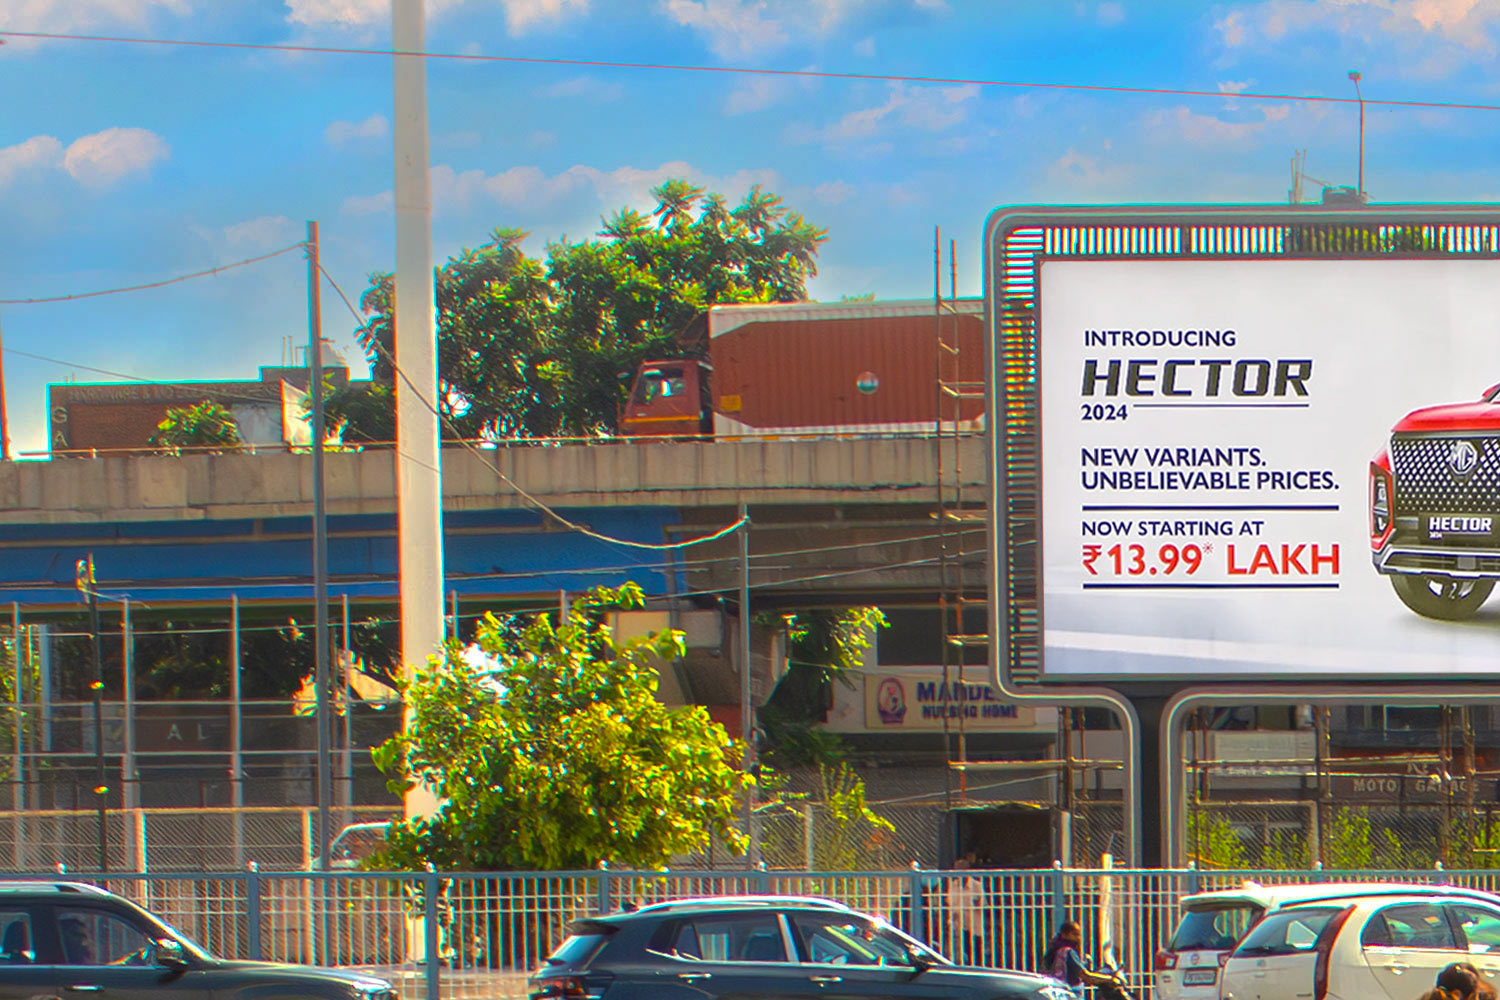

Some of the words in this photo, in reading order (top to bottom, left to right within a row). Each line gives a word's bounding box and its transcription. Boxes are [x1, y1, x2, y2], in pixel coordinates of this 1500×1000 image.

[1084, 330, 1236, 347] INTRODUCING
[1081, 359, 1312, 397] HECTOR
[1081, 404, 1128, 420] 2024
[1082, 449, 1138, 467] NEW
[1143, 448, 1266, 467] VARIANTS.
[1082, 472, 1250, 490] UNBELIEVABLE
[1257, 471, 1340, 490] PRICES.
[1082, 521, 1133, 536] NOW
[1138, 521, 1233, 536] STARTING
[1239, 521, 1264, 536] AT
[1429, 516, 1492, 532] HECTOR
[1227, 544, 1340, 575] LAKH
[981, 705, 1018, 719] HOME
[1353, 779, 1397, 792] MOTO
